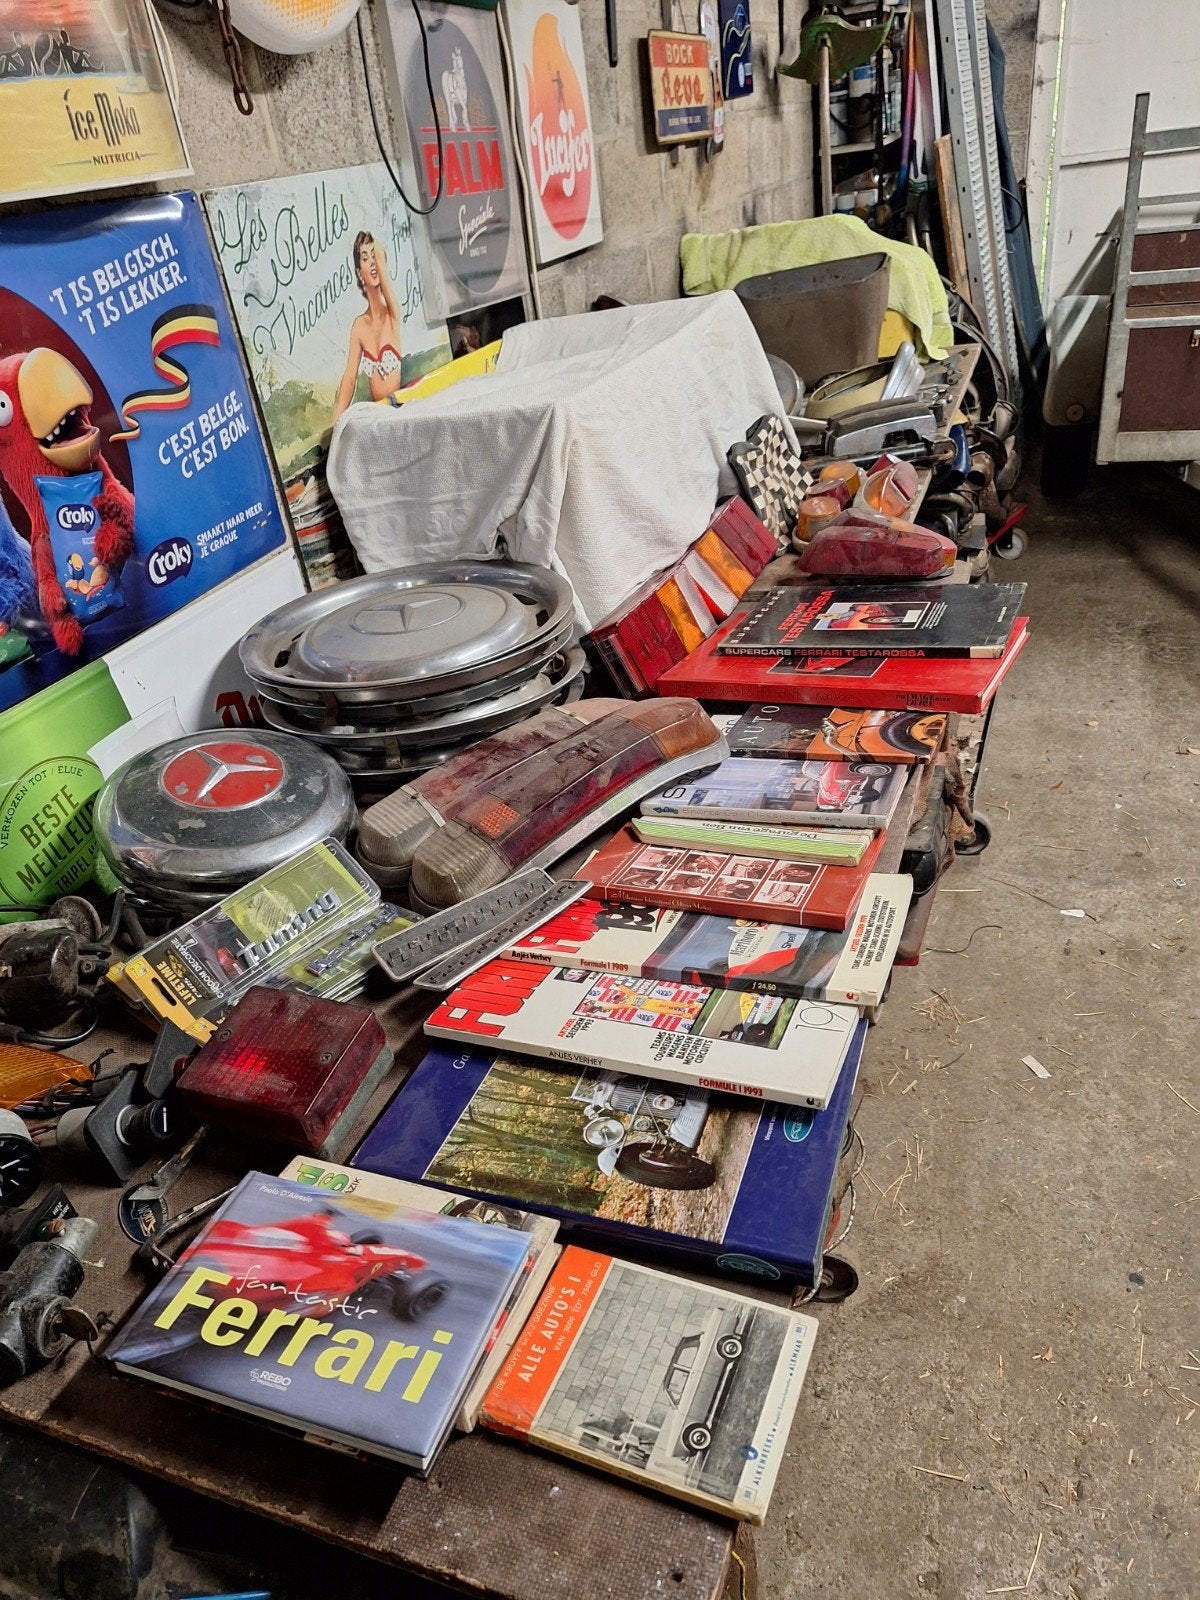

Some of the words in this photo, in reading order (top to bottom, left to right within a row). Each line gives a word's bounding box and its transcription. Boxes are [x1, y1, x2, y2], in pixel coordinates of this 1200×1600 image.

[665, 43, 694, 64] BOCK
[93, 150, 141, 166] NUTRICIA
[422, 138, 504, 198] PALM
[217, 191, 268, 274] Les
[244, 180, 349, 308] Belles
[68, 275, 94, 308] IS
[92, 232, 179, 296] BELGISCH.
[96, 295, 121, 328] IS
[119, 261, 188, 315] LEKKER.
[252, 255, 353, 355] Vacances
[158, 422, 196, 465] C'EST
[199, 390, 243, 436] BELGE.
[180, 438, 218, 479] C'EST
[220, 415, 250, 450] BON.
[58, 507, 95, 528] Croky
[197, 521, 226, 546] SMAAKT
[225, 511, 246, 532] NAAR
[245, 502, 263, 523] MEER
[200, 546, 211, 559] JE
[210, 530, 239, 553] CRAQUE
[147, 541, 192, 585] Croky
[777, 602, 810, 631] FERRARI
[778, 589, 836, 644] TESTAROSSA
[725, 648, 792, 656] SUPERCARS
[794, 648, 843, 657] FERRARI
[845, 649, 926, 657] TESTAROSSA
[738, 705, 780, 744] AUTO
[0, 785, 28, 849] VERKOZEN
[29, 769, 47, 786] TOT
[19, 784, 80, 849] BESTE
[753, 828, 800, 837] garage
[54, 856, 91, 895] TRIPEL
[530, 951, 552, 963] Verhey
[580, 958, 607, 969] Formule
[612, 963, 629, 972] 1989
[156, 961, 197, 1006] LIFETIME
[757, 982, 777, 991] 24.50
[566, 1017, 586, 1039] SEIZOEN
[580, 1019, 595, 1032] 1993
[650, 1031, 667, 1049] TEAMS
[574, 1054, 603, 1067] VERHEY
[654, 1032, 676, 1062] COUREURS
[666, 1034, 685, 1058] WAGENS
[676, 1036, 694, 1060] BANDEN
[682, 1038, 704, 1065] MOTOREN
[694, 1040, 713, 1064] CIRCUITS
[698, 1078, 738, 1092] FORMULE
[743, 1085, 763, 1096] 1993
[259, 1185, 280, 1195] Paolo
[280, 1189, 314, 1203] D'Alessio
[235, 1264, 379, 1320] fantastic
[153, 1265, 455, 1404] Ferrari
[497, 1379, 507, 1390] DE
[503, 1348, 523, 1377] KRUYFF
[534, 1285, 557, 1323] GOEZINNE
[518, 1344, 547, 1383] ALLE
[540, 1287, 576, 1340] AUTO'S
[554, 1335, 566, 1351] VAN
[563, 1316, 576, 1333] 3000
[573, 1298, 584, 1313] TOT
[260, 1370, 291, 1386] REBO
[753, 1433, 775, 1485] ALKENREEKS
[789, 1340, 803, 1372] ALKMAAR
